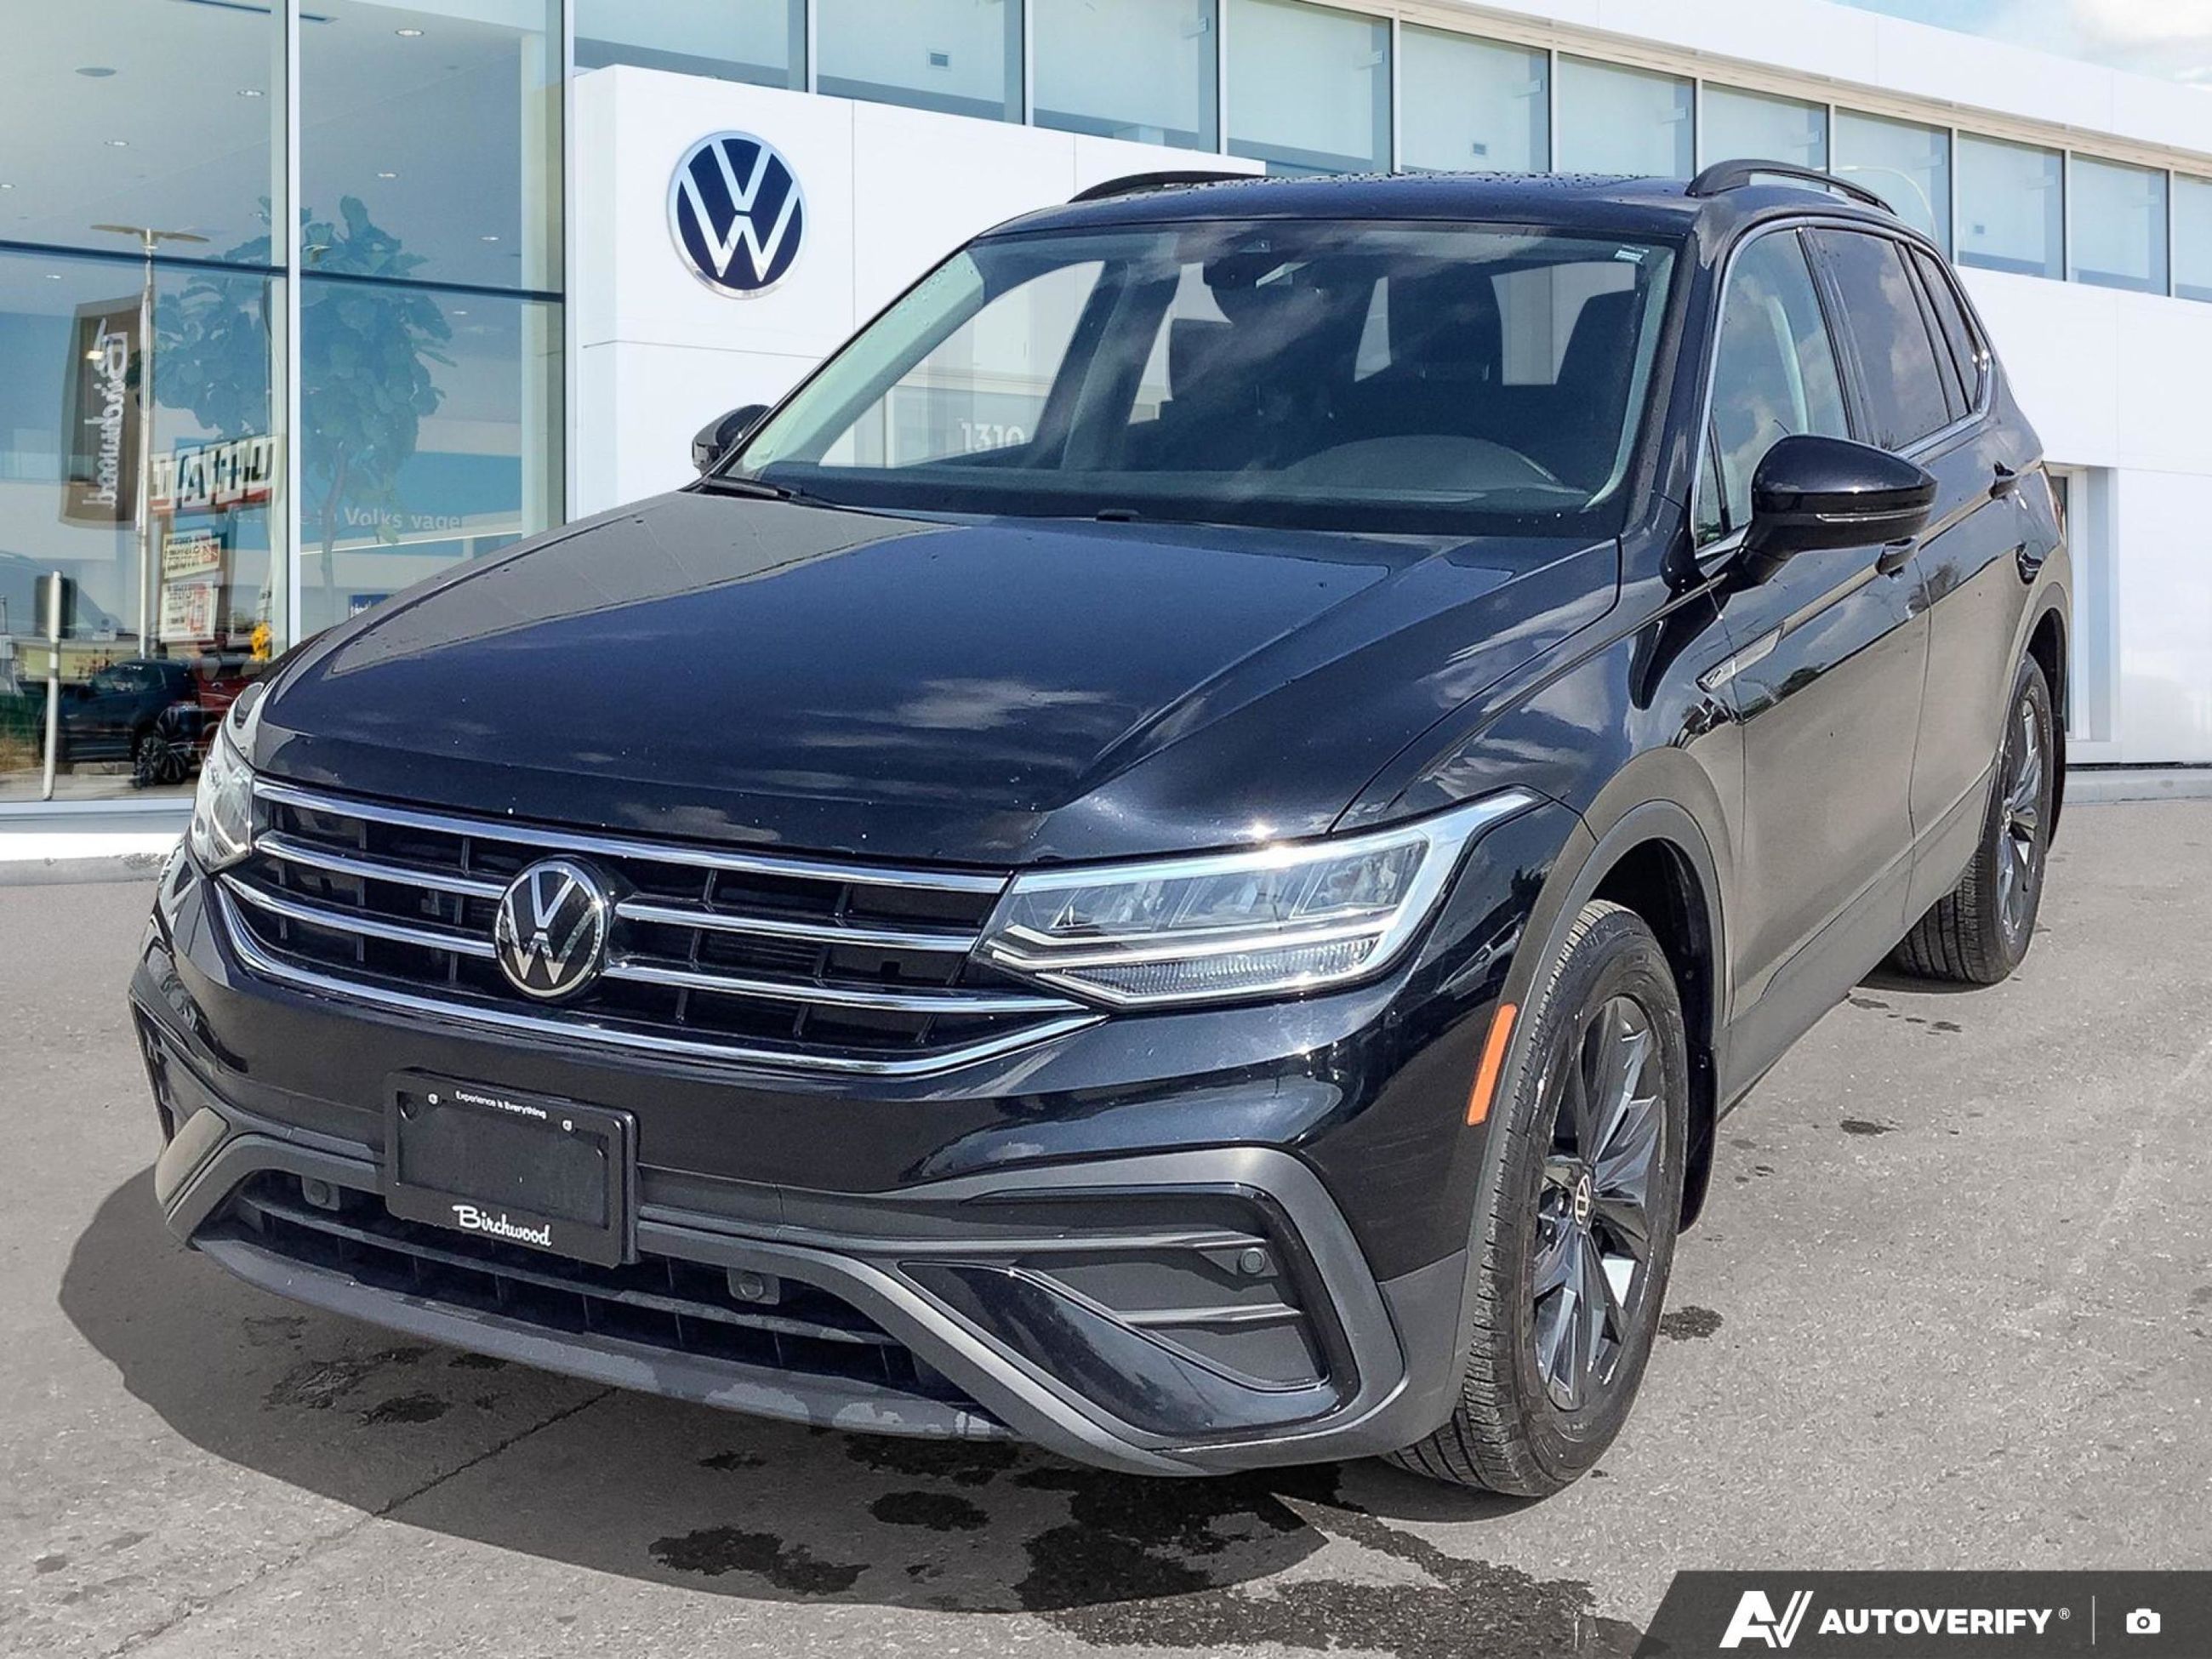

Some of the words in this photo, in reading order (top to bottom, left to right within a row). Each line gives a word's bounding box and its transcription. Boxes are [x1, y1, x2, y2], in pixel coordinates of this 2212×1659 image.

[672, 134, 806, 294] VW
[960, 422, 1024, 453] 1310
[495, 861, 604, 995] VW
[455, 1090, 496, 1107] Experience
[505, 1101, 547, 1120] Everything
[452, 1205, 552, 1247] Birchwood
